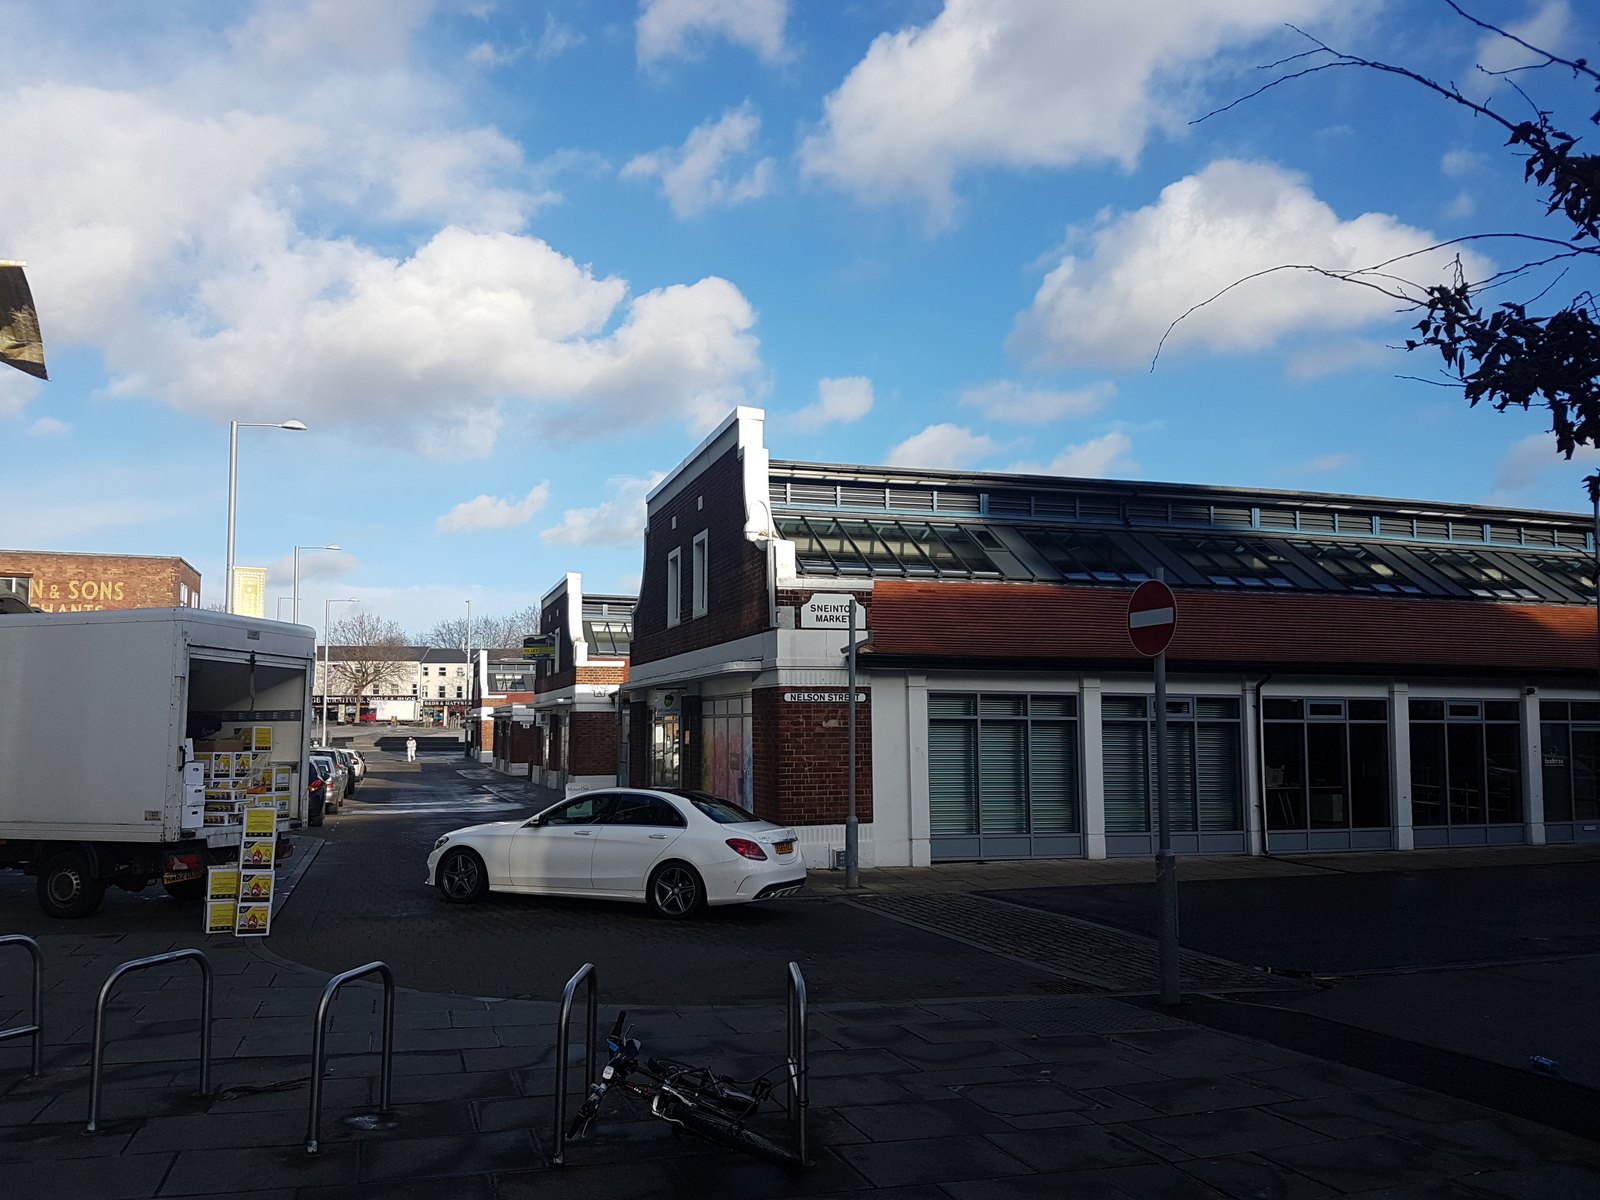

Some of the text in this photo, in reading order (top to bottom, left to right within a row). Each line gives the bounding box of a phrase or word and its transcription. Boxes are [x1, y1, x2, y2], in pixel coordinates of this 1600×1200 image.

[49, 584, 60, 599] &
[68, 580, 124, 600] SONS
[810, 604, 857, 613] SNEINTO
[790, 693, 860, 701] NELSON STRET
